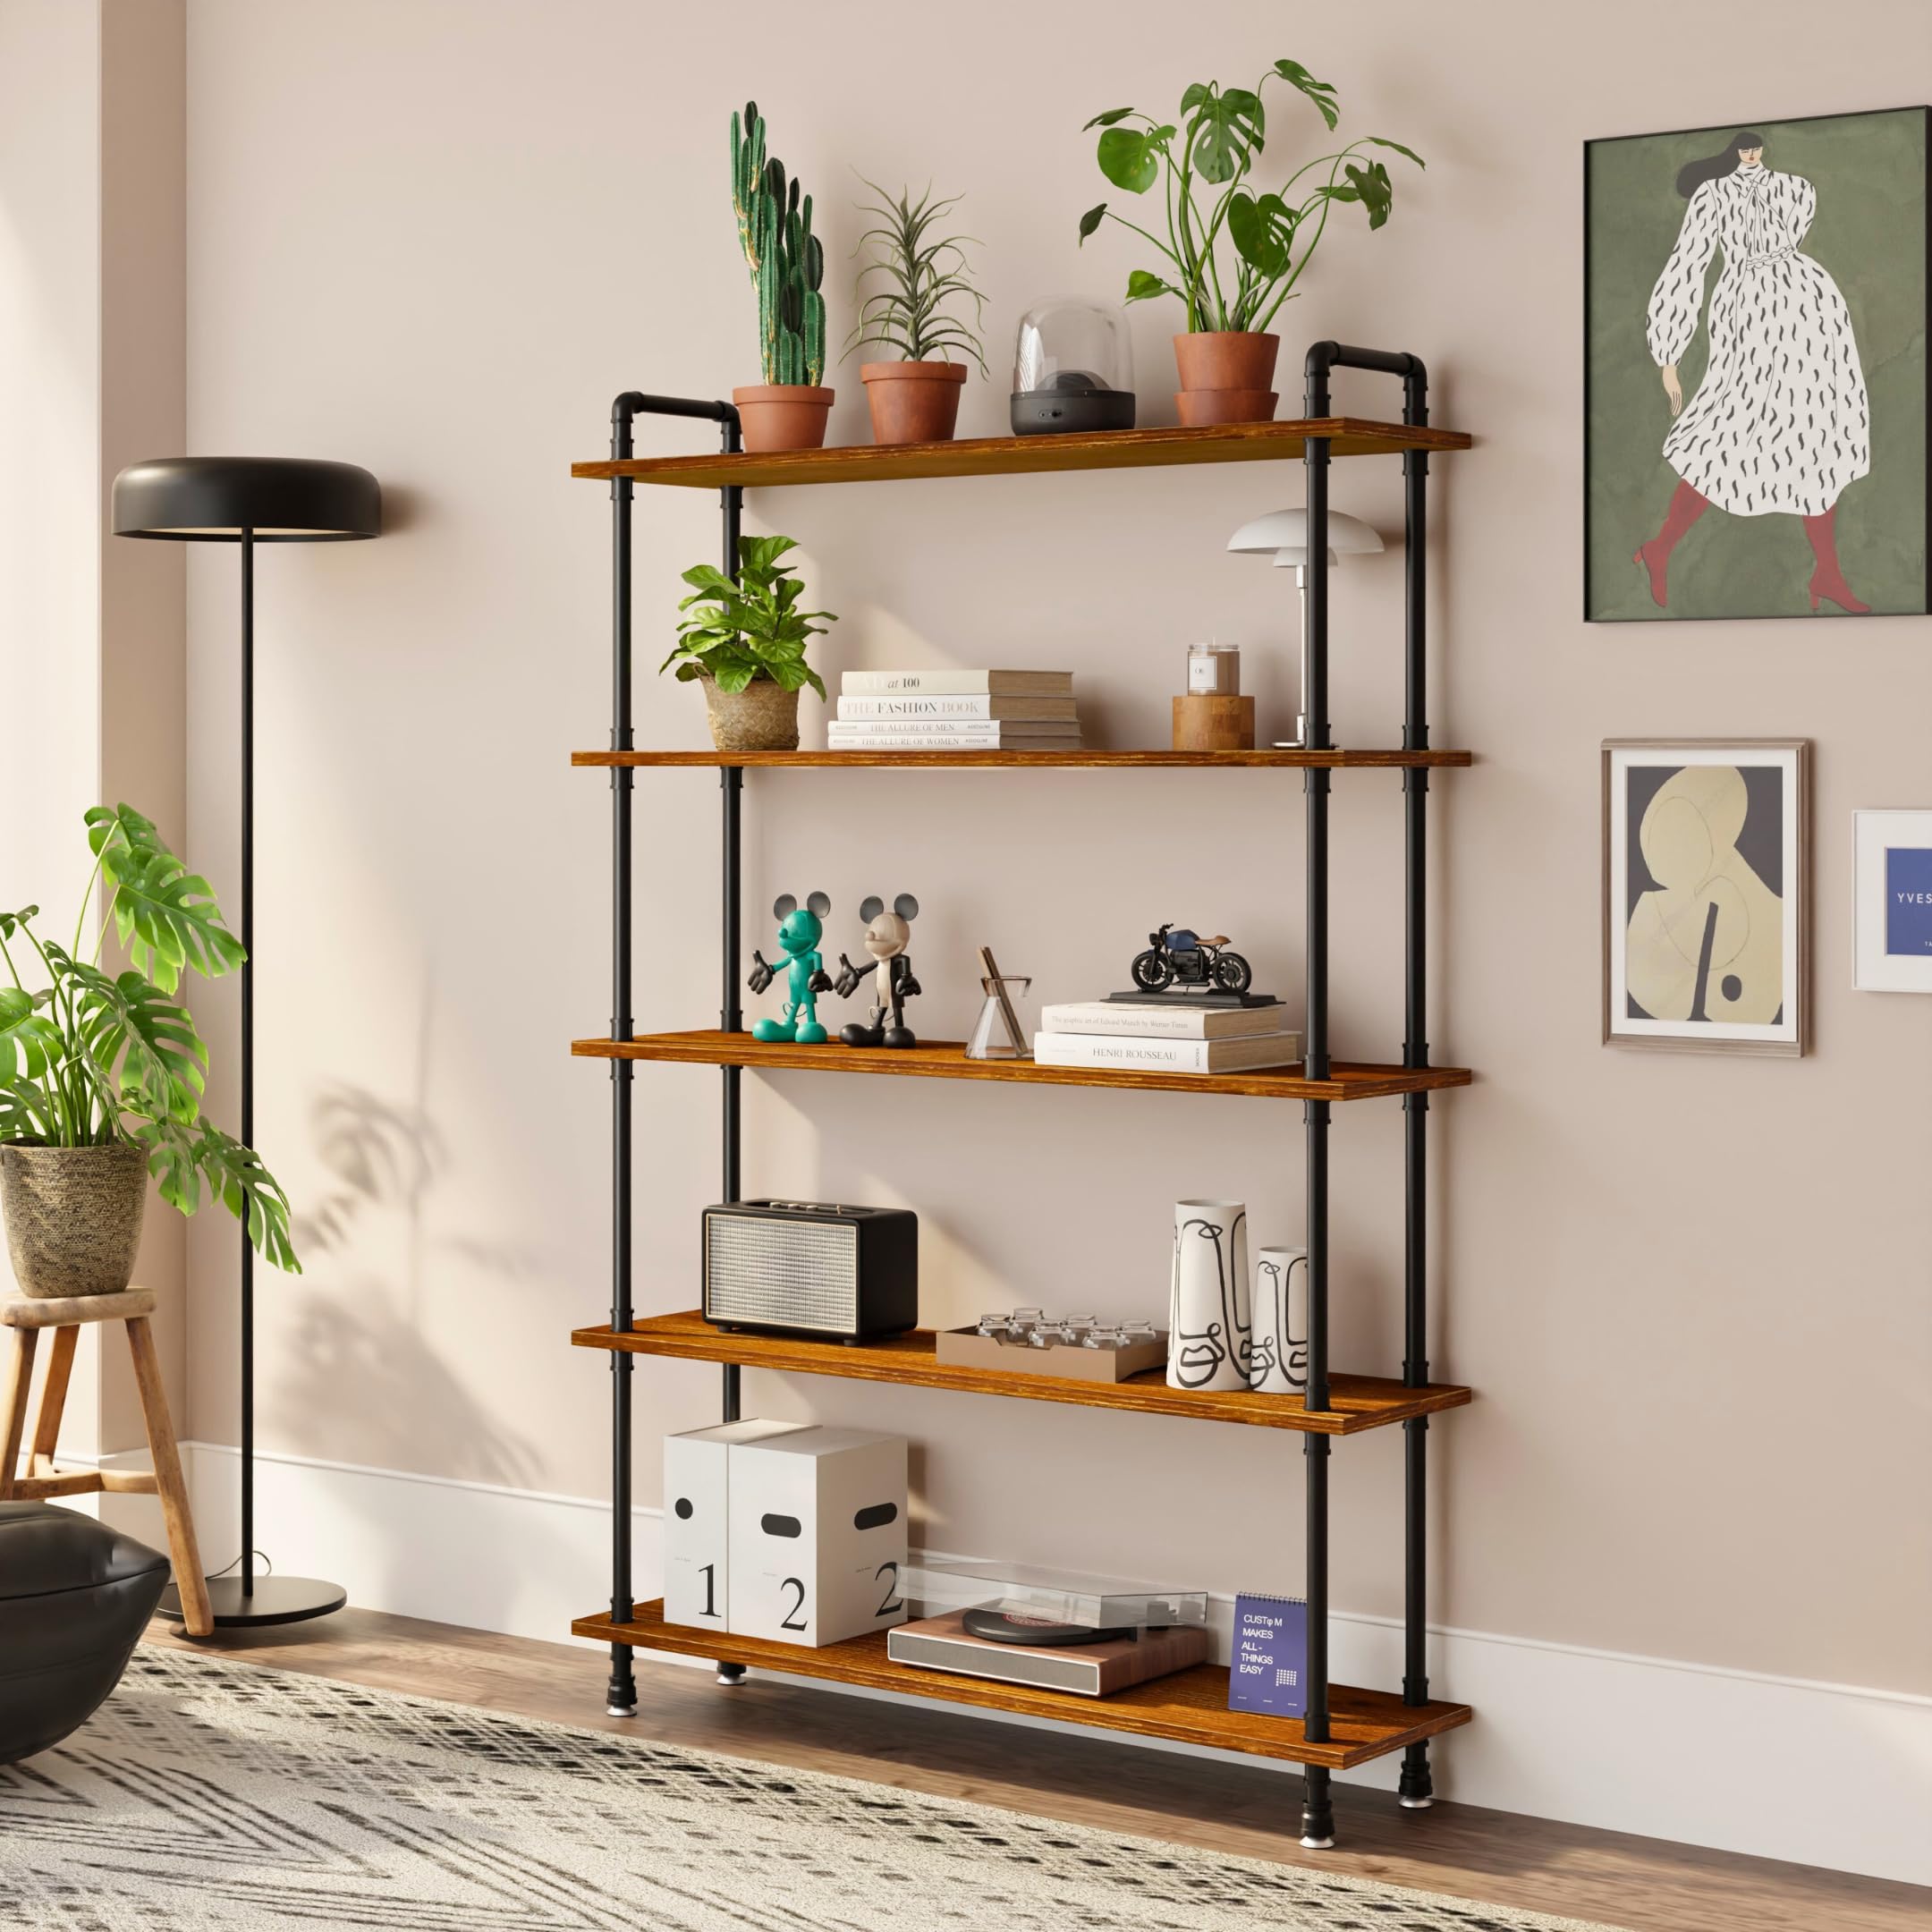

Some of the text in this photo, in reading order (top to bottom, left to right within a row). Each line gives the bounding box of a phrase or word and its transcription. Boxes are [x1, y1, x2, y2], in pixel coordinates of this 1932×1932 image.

[887, 679, 899, 689] at
[902, 677, 920, 688] 100
[844, 701, 979, 714] THE FASHION BOOK
[922, 724, 933, 732] OF
[936, 724, 955, 732] MEN
[879, 737, 911, 745] ALLURE
[913, 737, 924, 745] OF
[926, 737, 960, 745] WOMEN
[1897, 893, 1932, 904] YVES
[1093, 1047, 1177, 1060] HENRI ROUSSEAU
[699, 1563, 722, 1617] 1
[875, 1562, 903, 1617] 2
[780, 1577, 808, 1631] 2
[1242, 1628, 1274, 1639] MAKES
[1241, 1652, 1274, 1665] THINGS
[1240, 1664, 1264, 1675] EASY
